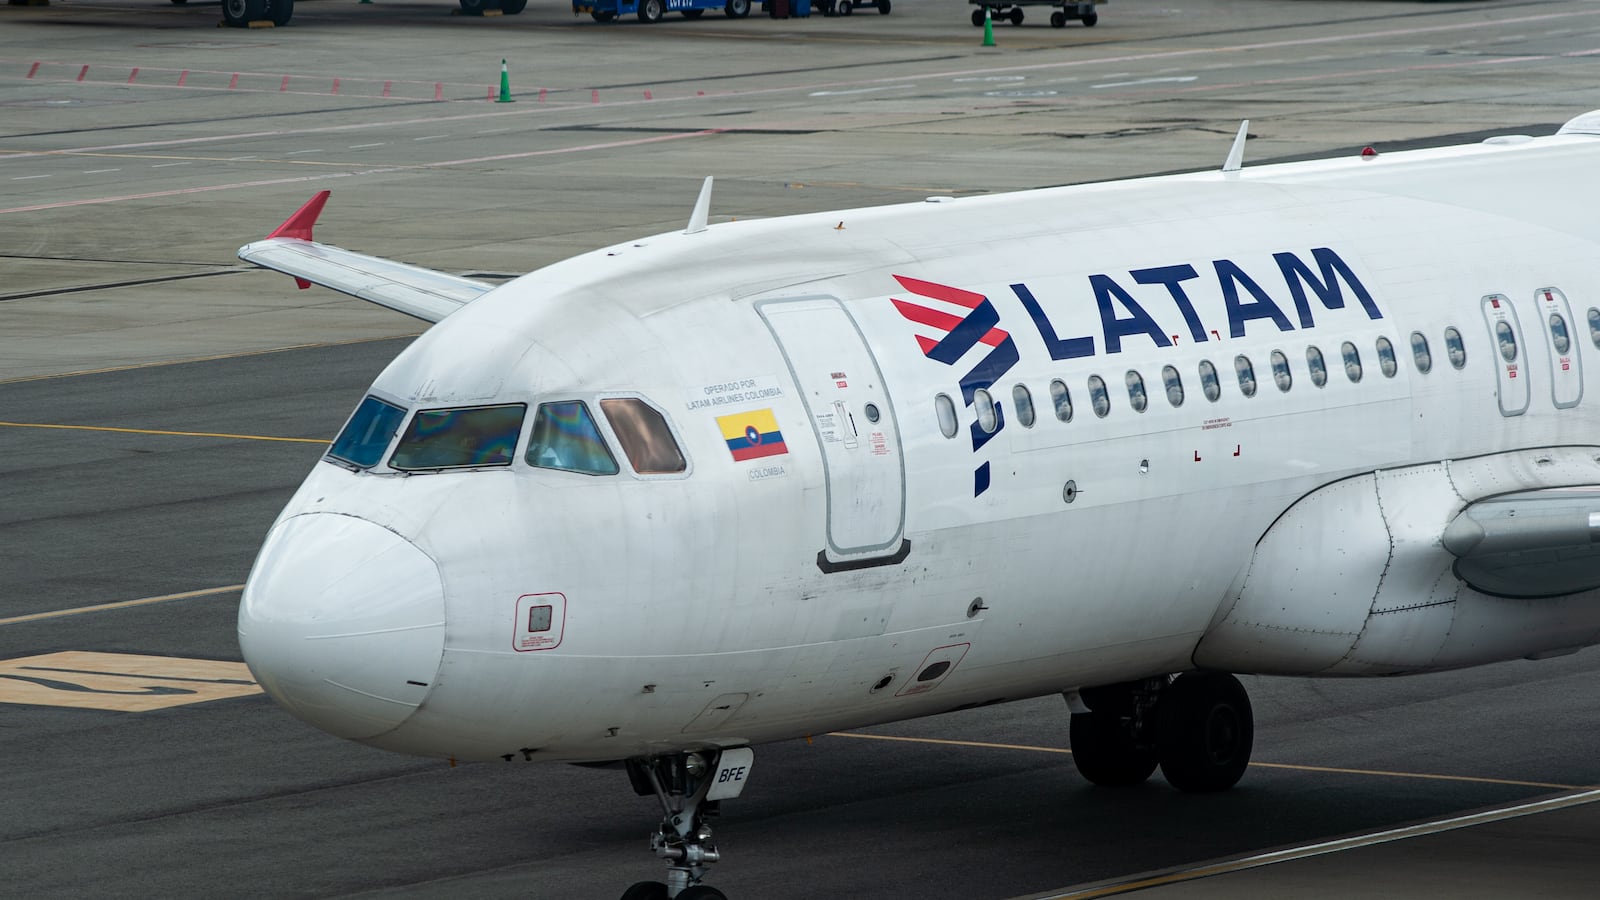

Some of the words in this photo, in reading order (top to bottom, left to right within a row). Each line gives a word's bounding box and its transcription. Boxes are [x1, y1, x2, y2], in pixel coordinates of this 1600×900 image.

[1009, 247, 1384, 361] LATAM
[704, 382, 740, 395] OPERADO
[740, 379, 757, 389] POR
[687, 399, 711, 410] LATAM
[712, 393, 745, 406] AIRLINES
[745, 387, 782, 400] COLOMBIA
[749, 466, 785, 479] COLOMBIA
[719, 767, 745, 782] BFE
